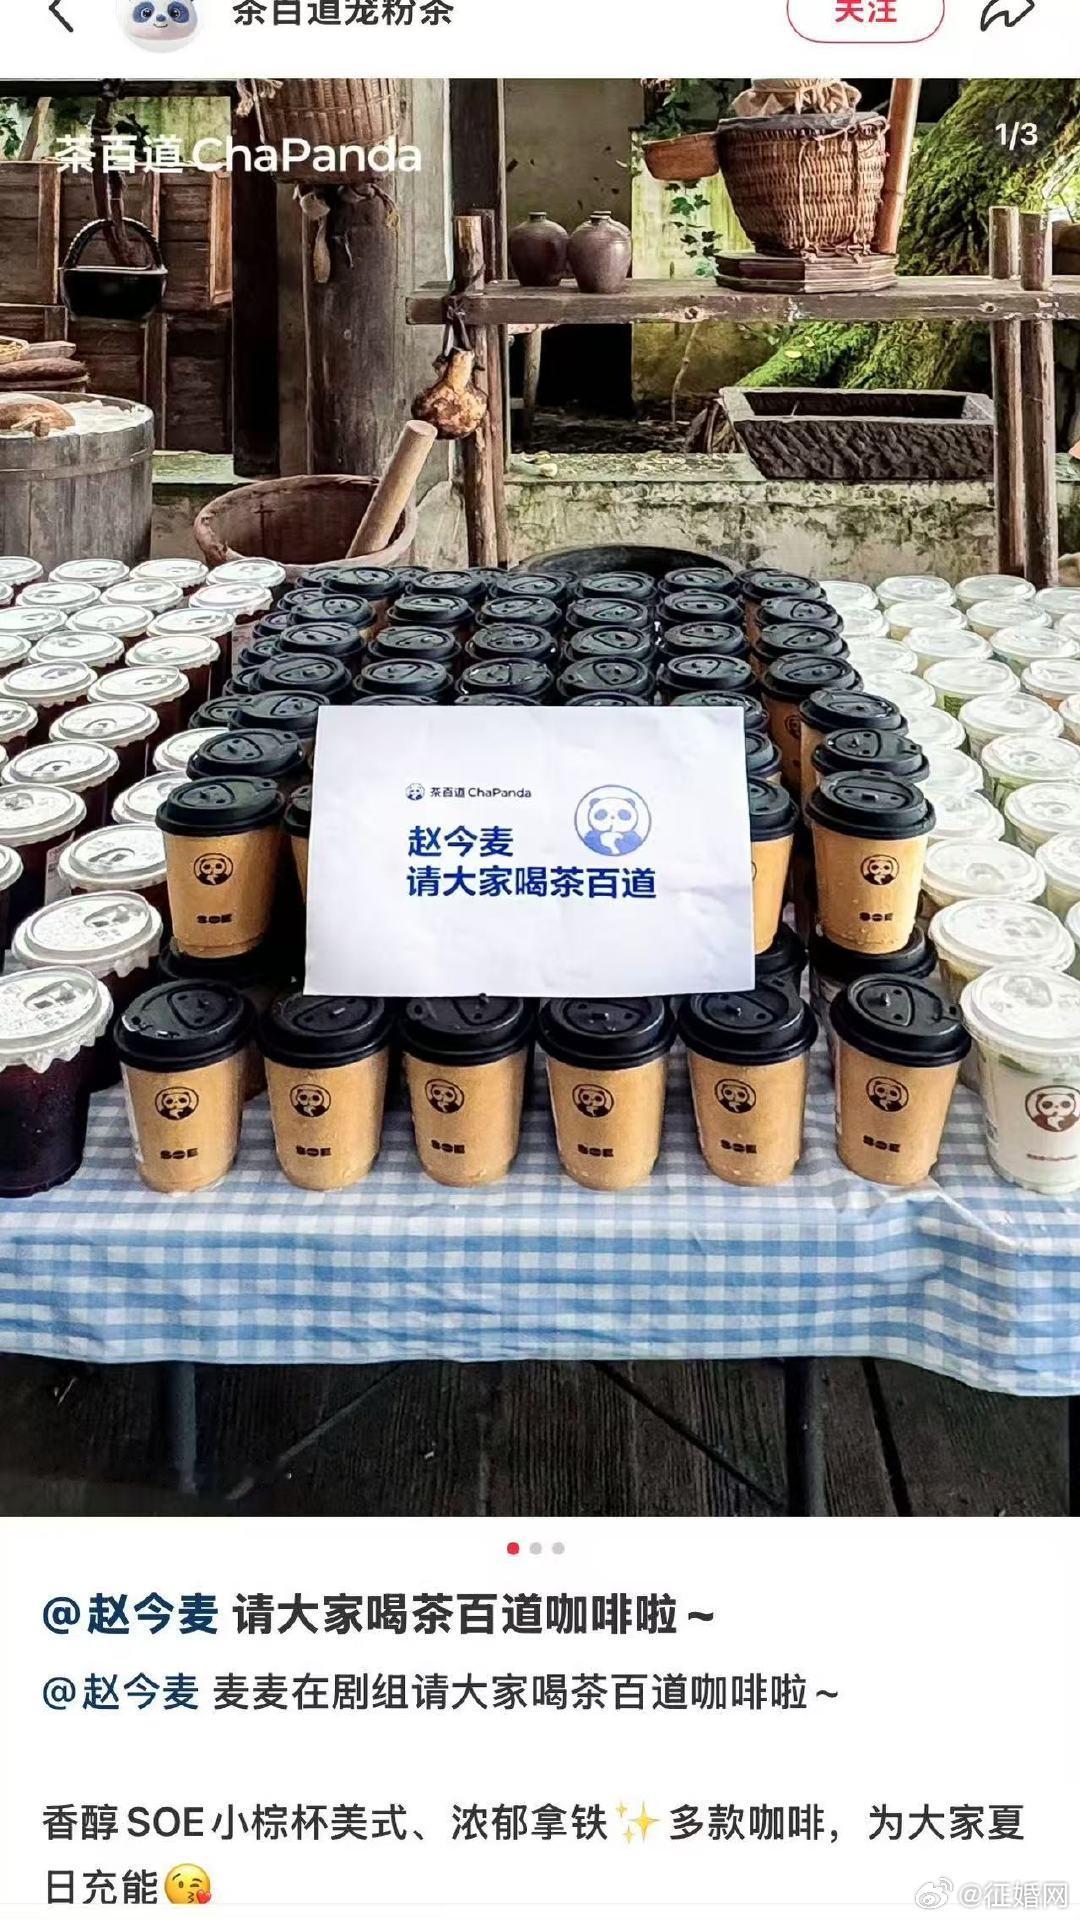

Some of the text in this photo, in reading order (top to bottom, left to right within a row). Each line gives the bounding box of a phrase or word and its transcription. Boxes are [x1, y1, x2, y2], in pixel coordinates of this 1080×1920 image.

[429, 786, 532, 799] 茶百道 ChaPanda
[407, 825, 514, 858] 赵今麦
[406, 864, 657, 899] 请大家喝茶百道
